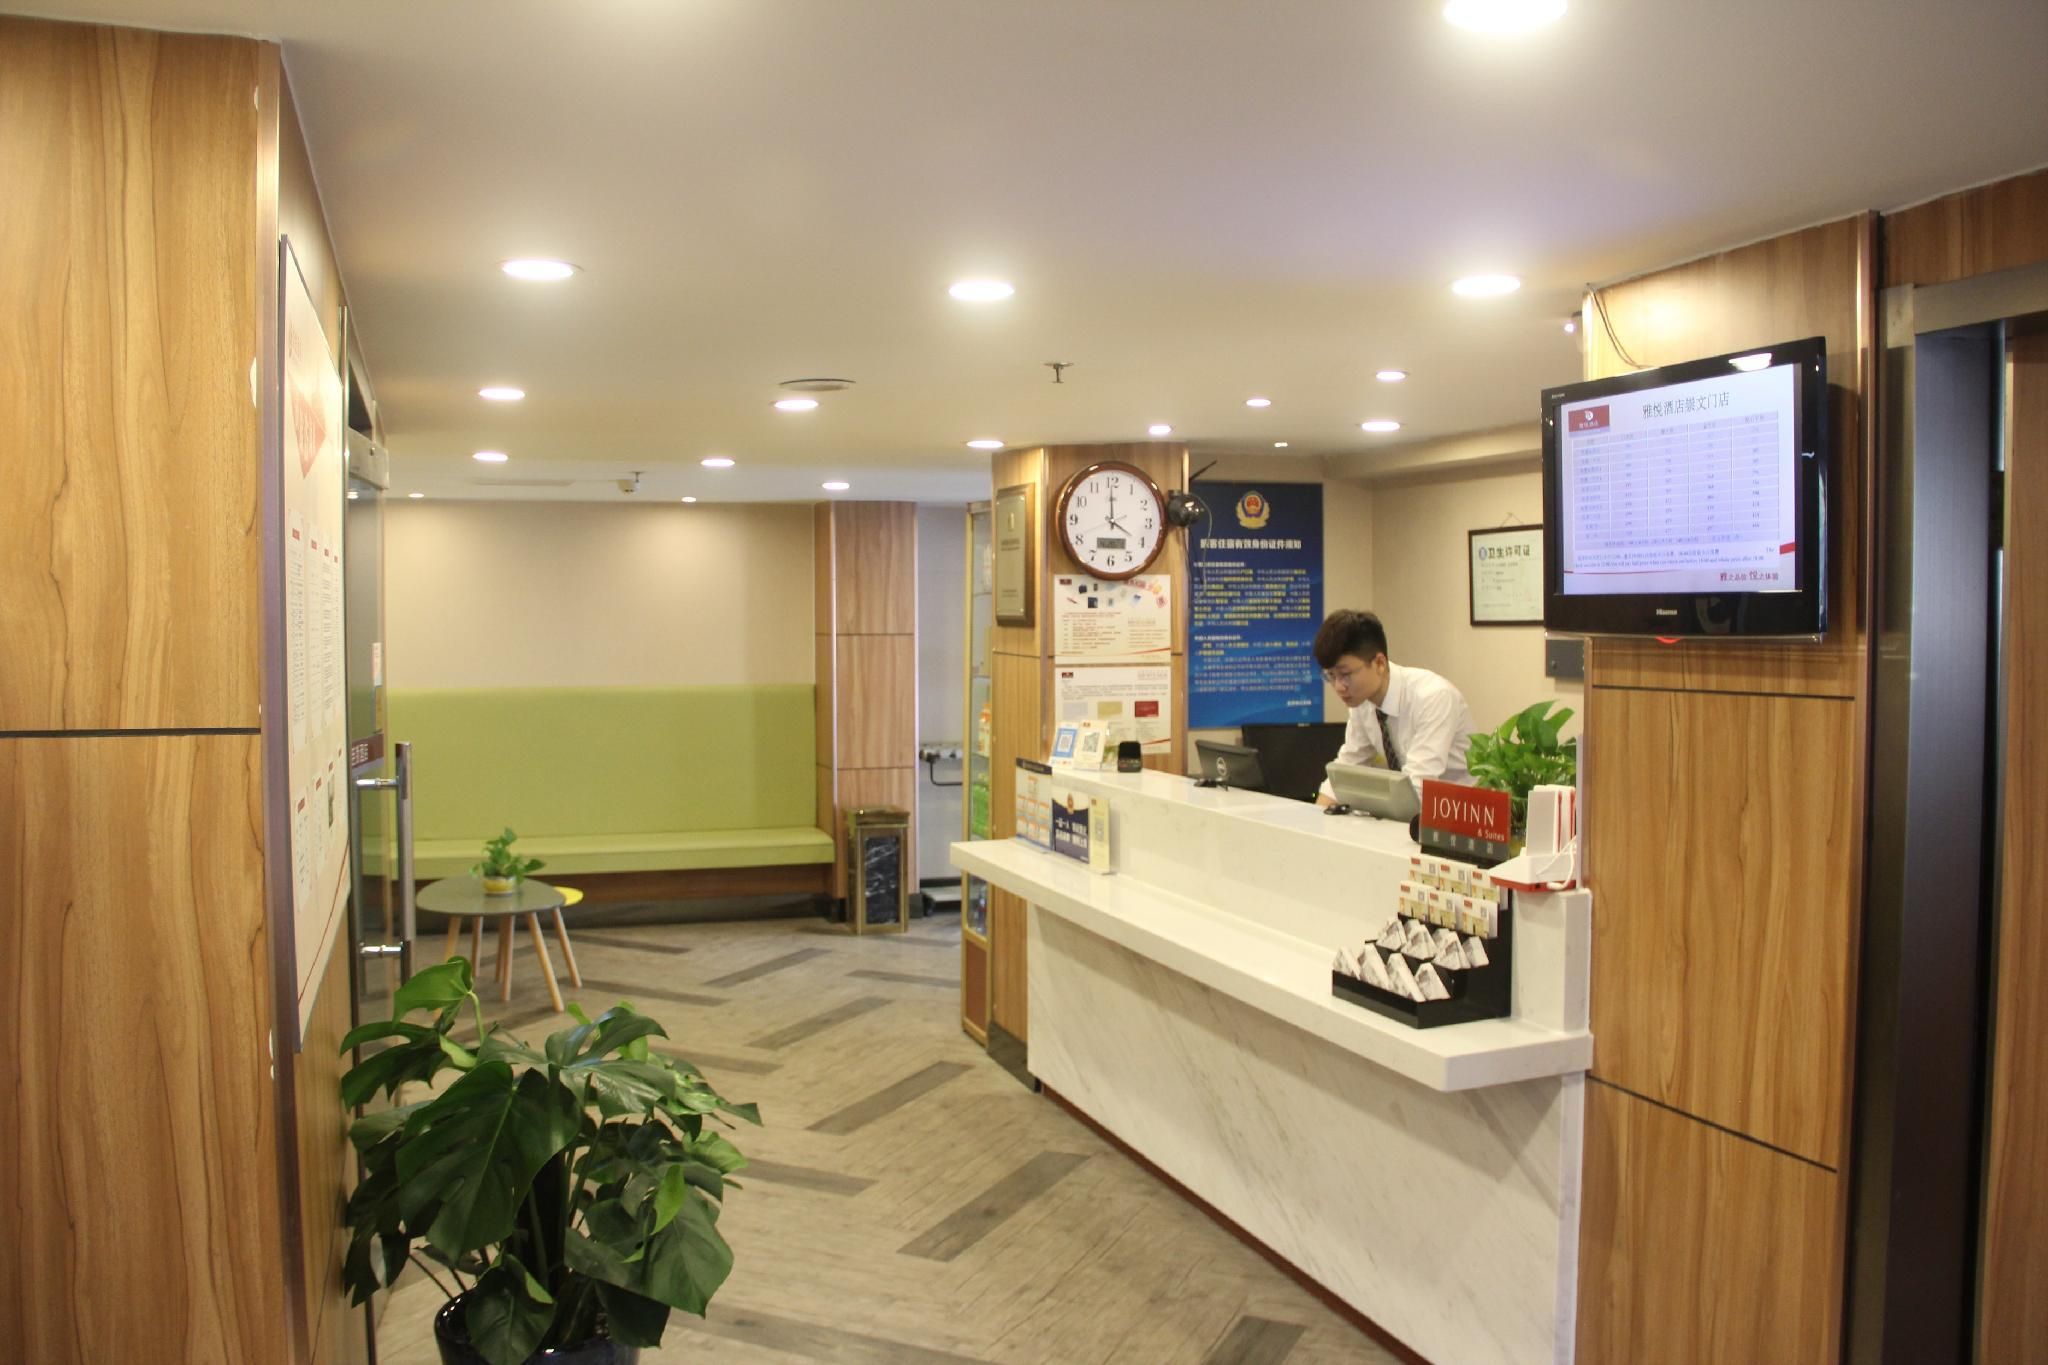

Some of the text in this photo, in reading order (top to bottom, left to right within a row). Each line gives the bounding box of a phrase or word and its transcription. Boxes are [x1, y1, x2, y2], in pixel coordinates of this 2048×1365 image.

[1642, 392, 1730, 419] 雅悦酒店崇文门店
[1090, 482, 1099, 493] 11
[1107, 477, 1119, 488] 12
[1129, 484, 1134, 495] 1
[1077, 496, 1087, 508] 10
[1140, 500, 1148, 511] 2
[1070, 514, 1078, 526] 9
[1145, 518, 1153, 529] 3
[1075, 534, 1083, 545] 8
[1138, 537, 1145, 548] 4
[1089, 550, 1097, 562] 7
[1125, 551, 1132, 562] 5
[1488, 545, 1531, 559] 卫生许可证
[1107, 555, 1115, 567] 6
[1432, 797, 1495, 827] JOYINN
[1484, 829, 1505, 841] Suites
